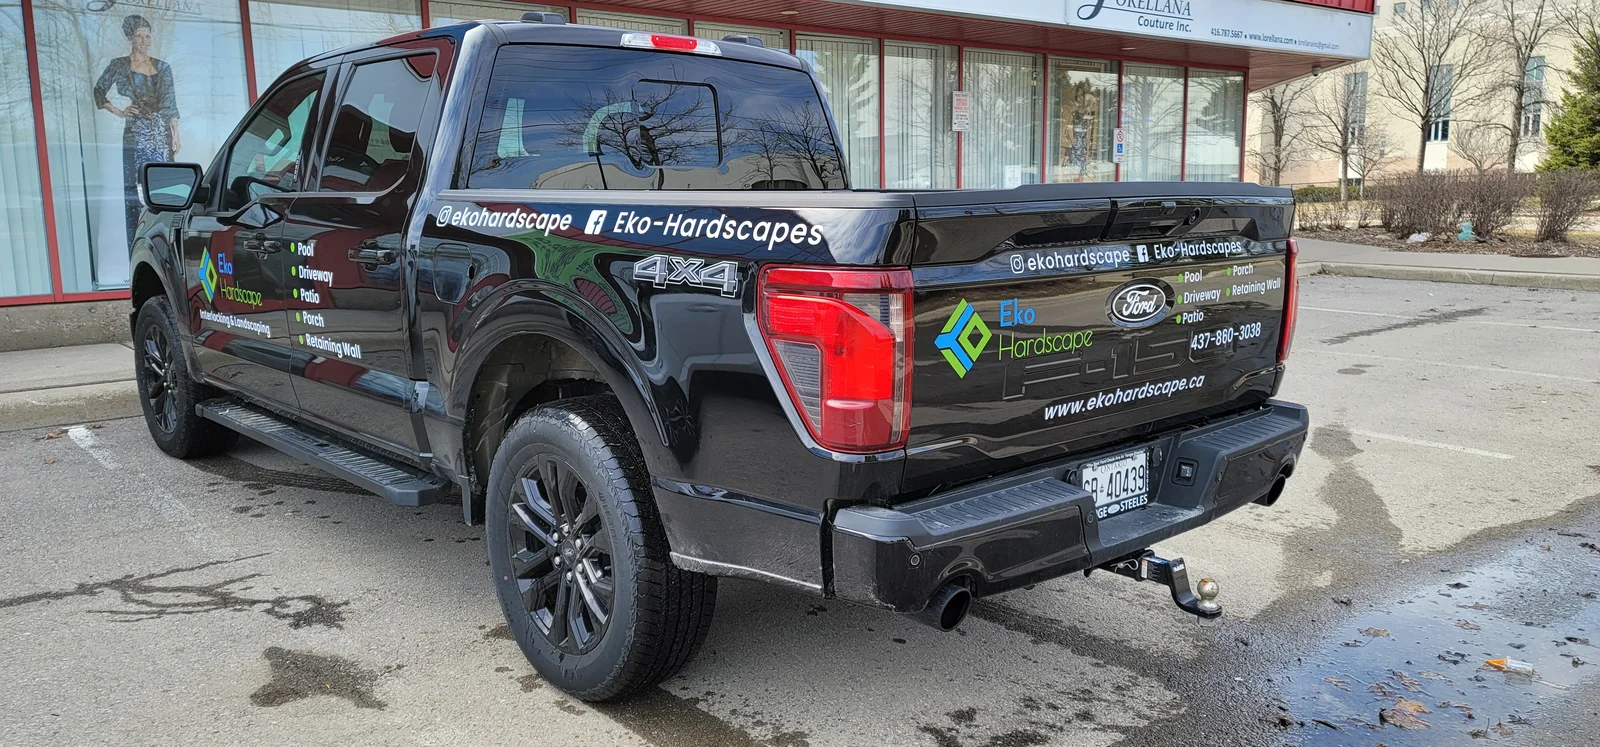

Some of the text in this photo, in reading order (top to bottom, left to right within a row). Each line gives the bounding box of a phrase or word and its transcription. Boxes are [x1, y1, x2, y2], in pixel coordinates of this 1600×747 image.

[1138, 15, 1192, 33] Couture Inc.
[451, 206, 572, 237] ekohardscape
[613, 210, 824, 251] Eko-Hardscapes
[297, 242, 314, 257] Pool
[1153, 240, 1242, 260] Eko-Hardscapes
[217, 253, 233, 275] Eko
[1027, 250, 1130, 272] ekohardscape
[1232, 263, 1254, 277] Porch
[298, 265, 333, 287] Driveway
[1184, 269, 1203, 284] Pool
[1232, 277, 1281, 297] Retaining Wall
[219, 278, 263, 309] Hardscape
[300, 288, 320, 304] Patio
[1122, 290, 1158, 316] Ford
[1183, 287, 1222, 304] Driveway
[199, 308, 231, 329] Interlocking
[234, 315, 271, 339] Landscaping
[303, 311, 325, 327] Porch
[1000, 298, 1036, 327] Eko
[1182, 311, 1204, 325] Patio
[305, 333, 362, 359] Retaining Wall
[998, 328, 1094, 361] Hardscape
[1190, 321, 1262, 350] 437-860-3038
[1044, 374, 1206, 421] www.ekohardscape.ca
[1106, 464, 1145, 500] 40439
[1120, 494, 1148, 512] STEELES
